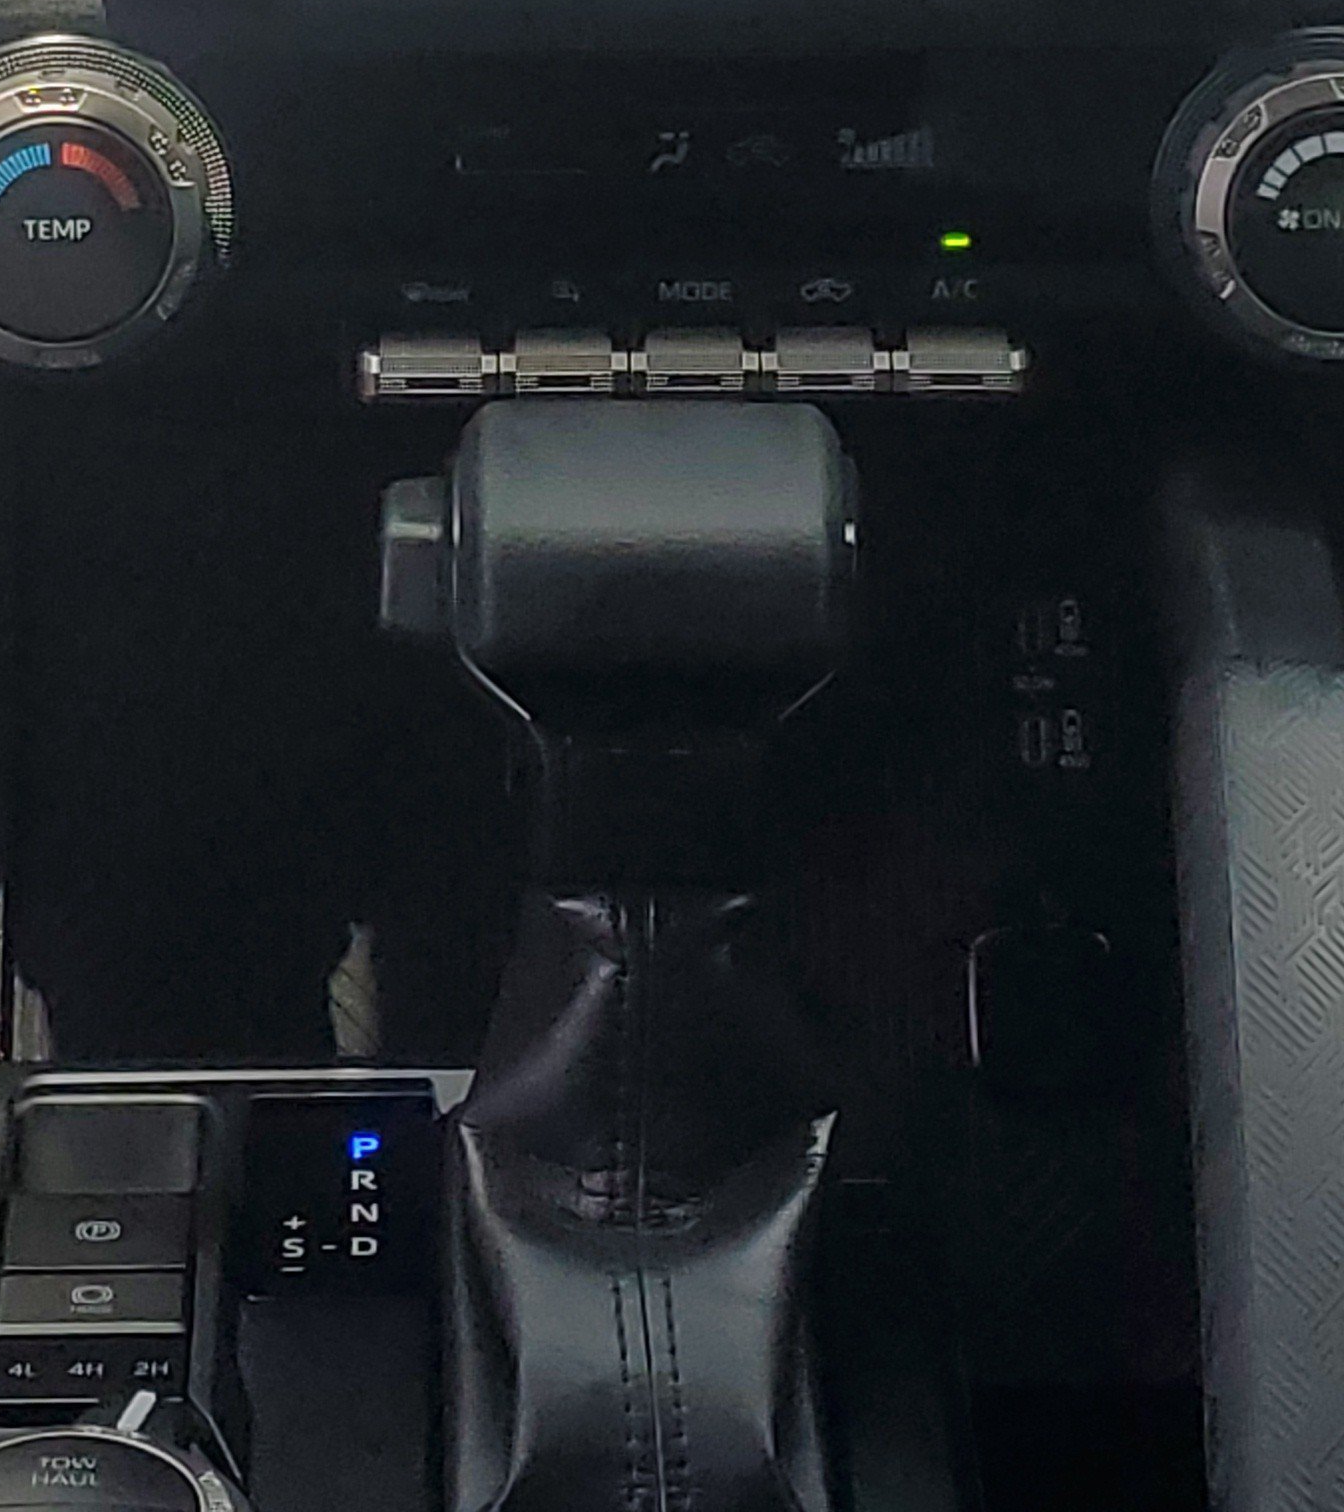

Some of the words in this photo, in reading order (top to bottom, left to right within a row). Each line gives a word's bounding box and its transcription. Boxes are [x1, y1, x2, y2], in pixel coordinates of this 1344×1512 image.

[23, 219, 92, 241] TEMP
[658, 281, 732, 302] MODE
[931, 279, 978, 300] A/C
[349, 1135, 379, 1159] P
[351, 1169, 378, 1190] R
[351, 1203, 378, 1223] N
[283, 1237, 304, 1258] S
[351, 1237, 378, 1257] D
[7, 1362, 36, 1378] 4L
[68, 1361, 103, 1378] 4H
[133, 1360, 169, 1377] 2H
[41, 1456, 97, 1469] TOW
[32, 1472, 98, 1487] HAUL
